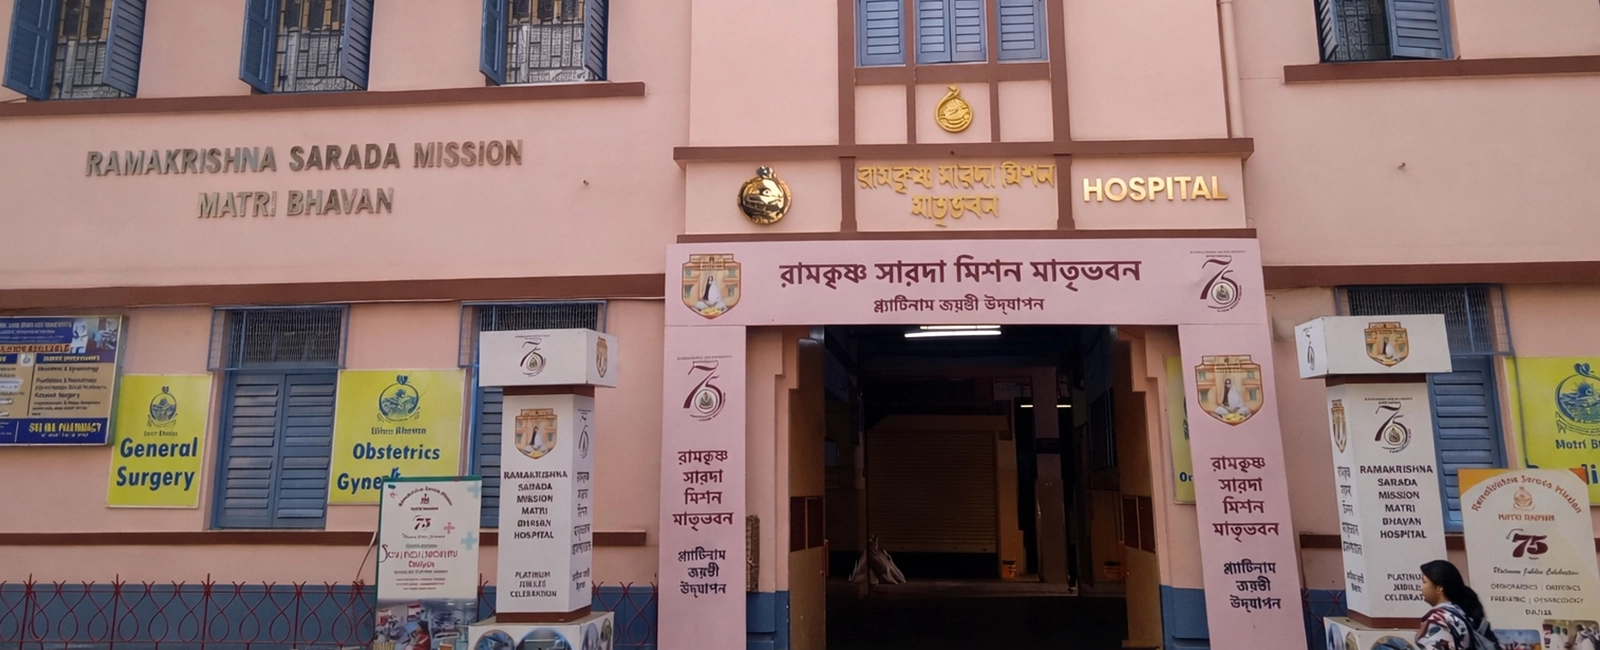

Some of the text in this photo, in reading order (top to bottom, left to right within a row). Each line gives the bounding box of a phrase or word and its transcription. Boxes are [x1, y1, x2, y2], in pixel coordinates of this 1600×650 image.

[85, 139, 523, 177] RAMAKRISHNA SARADA MISSION
[1083, 176, 1228, 202] HOSPITAL
[197, 187, 394, 218] MATRI BHAVAN
[779, 254, 1142, 292] রামকৃষ্ণ সারদা মিশন মাতৃভবন
[120, 437, 198, 458] General
[352, 442, 440, 460] Obstetrics
[677, 450, 729, 466] রামকৃষ্ণ
[1210, 456, 1265, 473] রামকৃষ্ণ
[116, 465, 195, 490] Surgery
[683, 469, 723, 485] সারদা
[1360, 465, 1433, 474] RAMAKRISHNA
[337, 472, 388, 495] Gyne
[1218, 477, 1262, 494] সারদা
[1377, 478, 1418, 487] SARADA
[684, 487, 722, 505] মিশন
[1378, 491, 1420, 499] MISSION
[1222, 496, 1265, 514] মিশন
[1385, 504, 1416, 513] MATRI
[673, 512, 734, 531] মাতৃভবন
[513, 531, 555, 539] HOSPITAL
[1212, 521, 1279, 542] মাতৃভবন
[1380, 530, 1427, 539] HOSPITAL
[1512, 533, 1549, 558] 75
